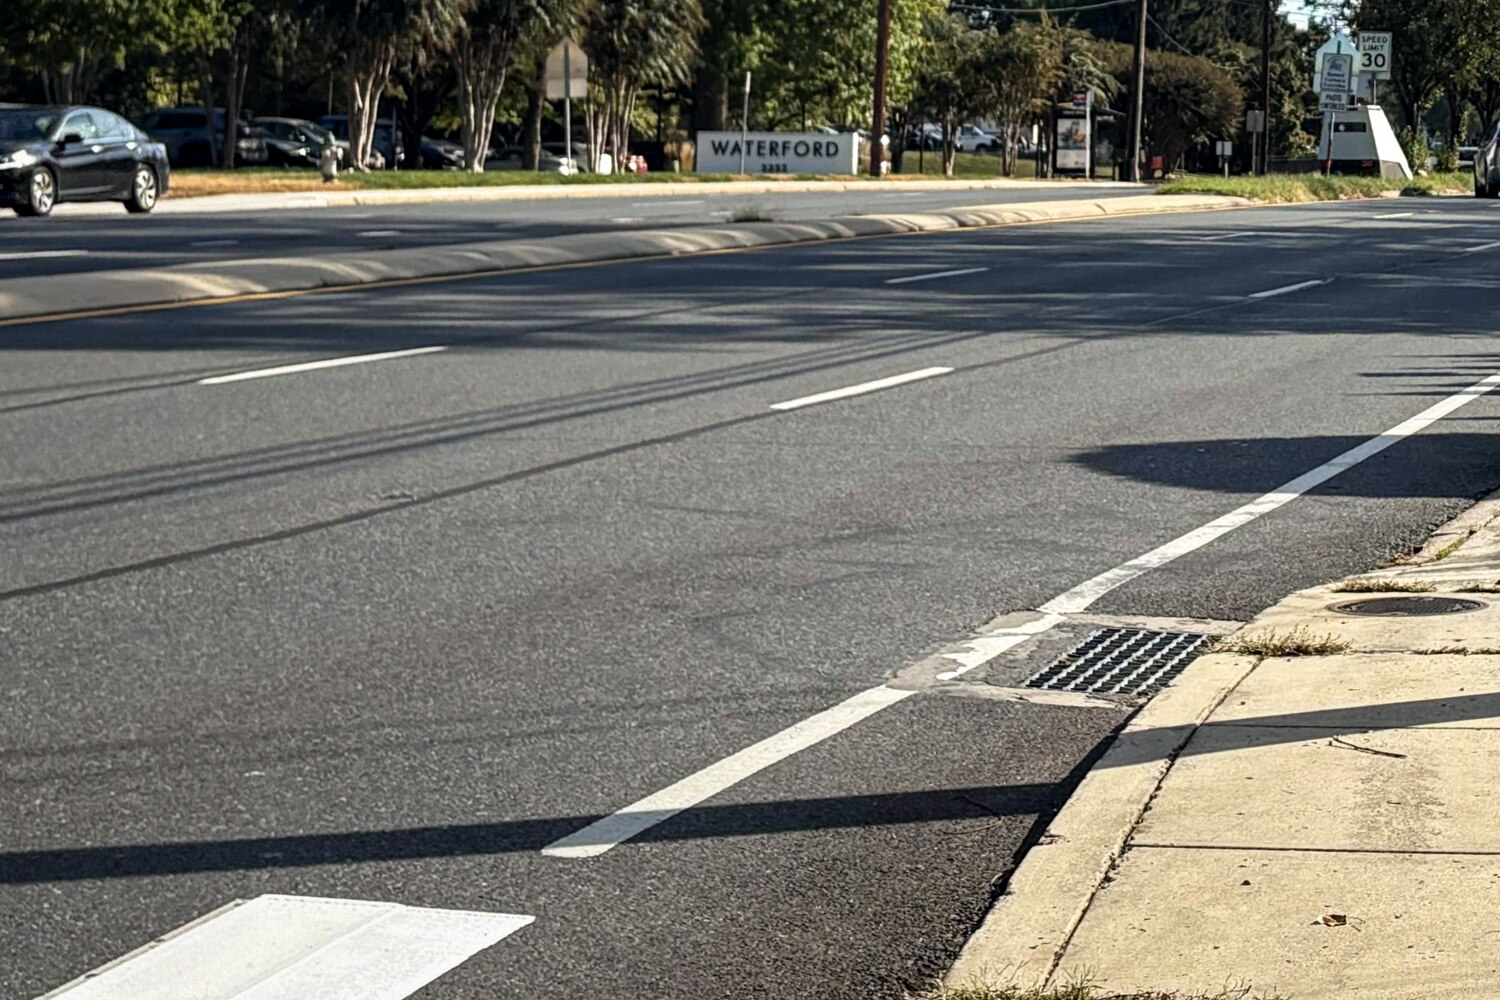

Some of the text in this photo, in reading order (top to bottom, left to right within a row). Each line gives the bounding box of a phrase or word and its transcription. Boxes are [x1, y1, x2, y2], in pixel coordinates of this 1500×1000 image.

[1361, 35, 1388, 44] SPEED
[1361, 52, 1386, 68] 30
[711, 139, 839, 157] WATERFORD
